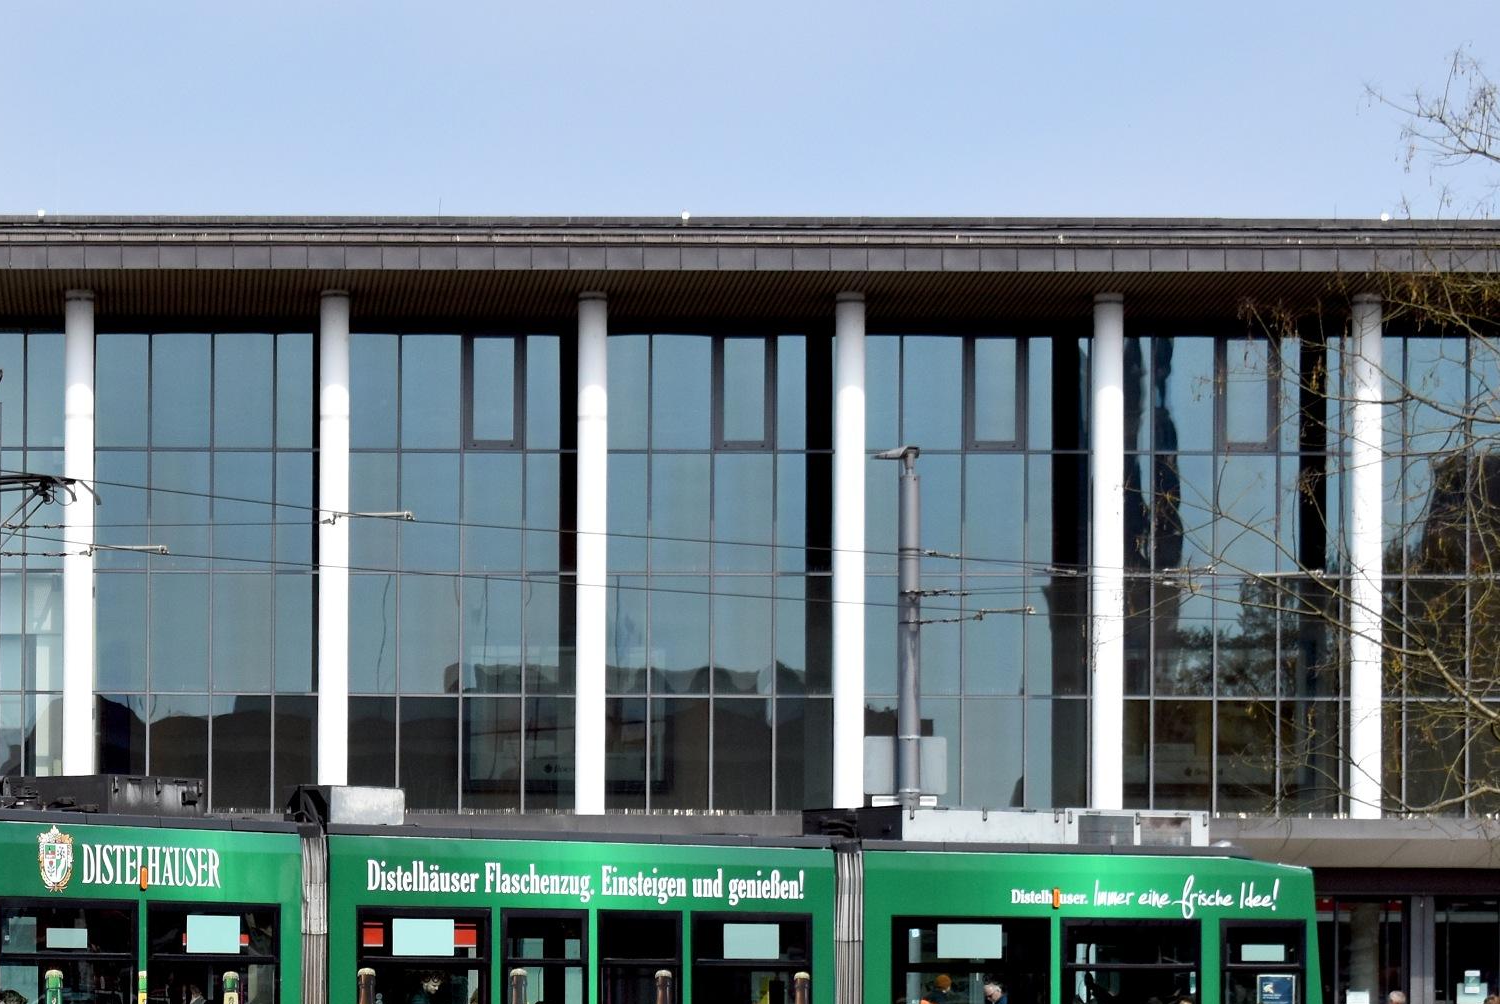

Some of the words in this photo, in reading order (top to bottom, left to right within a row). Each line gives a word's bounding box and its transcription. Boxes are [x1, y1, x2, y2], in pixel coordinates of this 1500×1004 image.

[81, 843, 221, 888] DISTELHÄUSER
[366, 859, 480, 894] Distelhäuser
[484, 862, 595, 903] Flaschenzug.
[601, 865, 687, 905] Einsteigen
[692, 868, 723, 899] und
[728, 870, 805, 906] genießen!
[1011, 889, 1088, 905] Distelhuser.
[1093, 880, 1135, 907] Immer
[1137, 888, 1171, 907] eine
[1171, 874, 1233, 919] frische
[1239, 878, 1279, 912] Idee!
